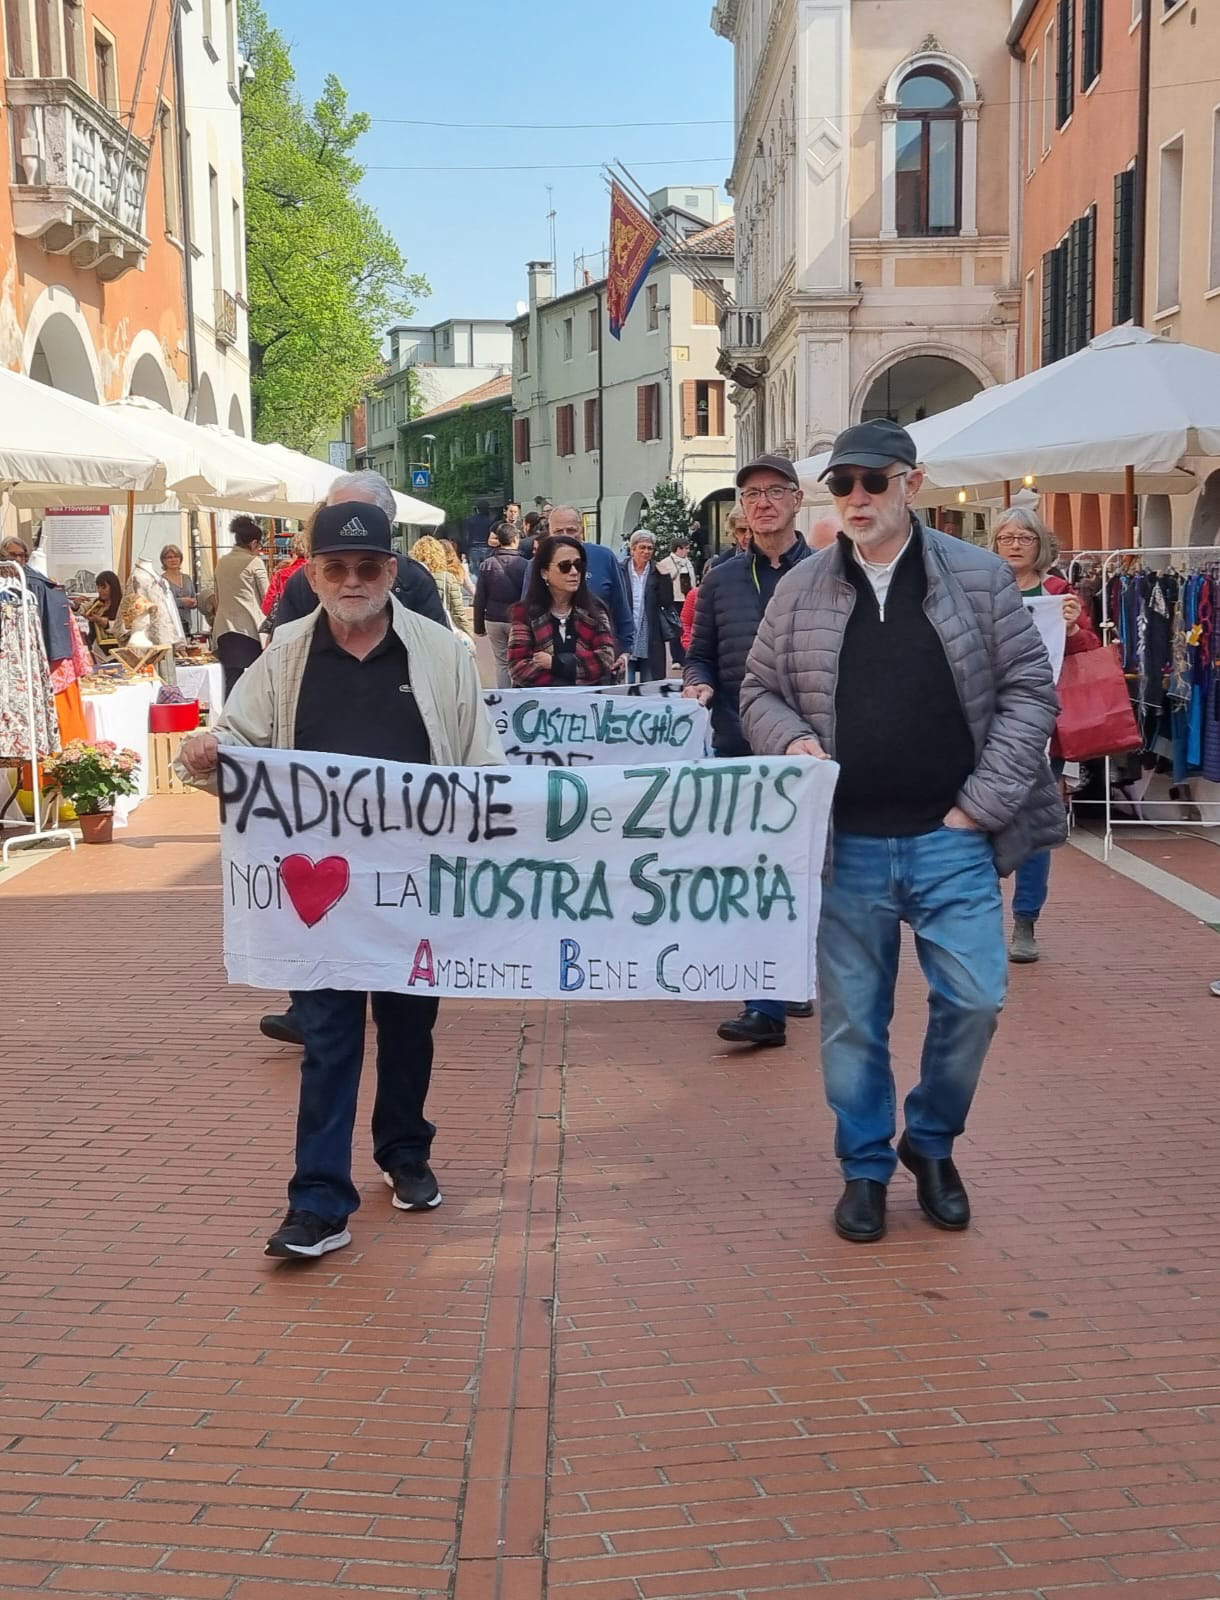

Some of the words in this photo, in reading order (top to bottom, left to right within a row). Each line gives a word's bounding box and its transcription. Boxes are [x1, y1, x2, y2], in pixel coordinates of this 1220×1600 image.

[546, 769, 613, 842] De
[230, 855, 282, 910] NOi
[375, 871, 422, 908] LA
[428, 853, 614, 922] NOSTRA
[629, 852, 797, 926] STORiA
[559, 937, 639, 992] BENE
[656, 943, 777, 994] COMUNE
